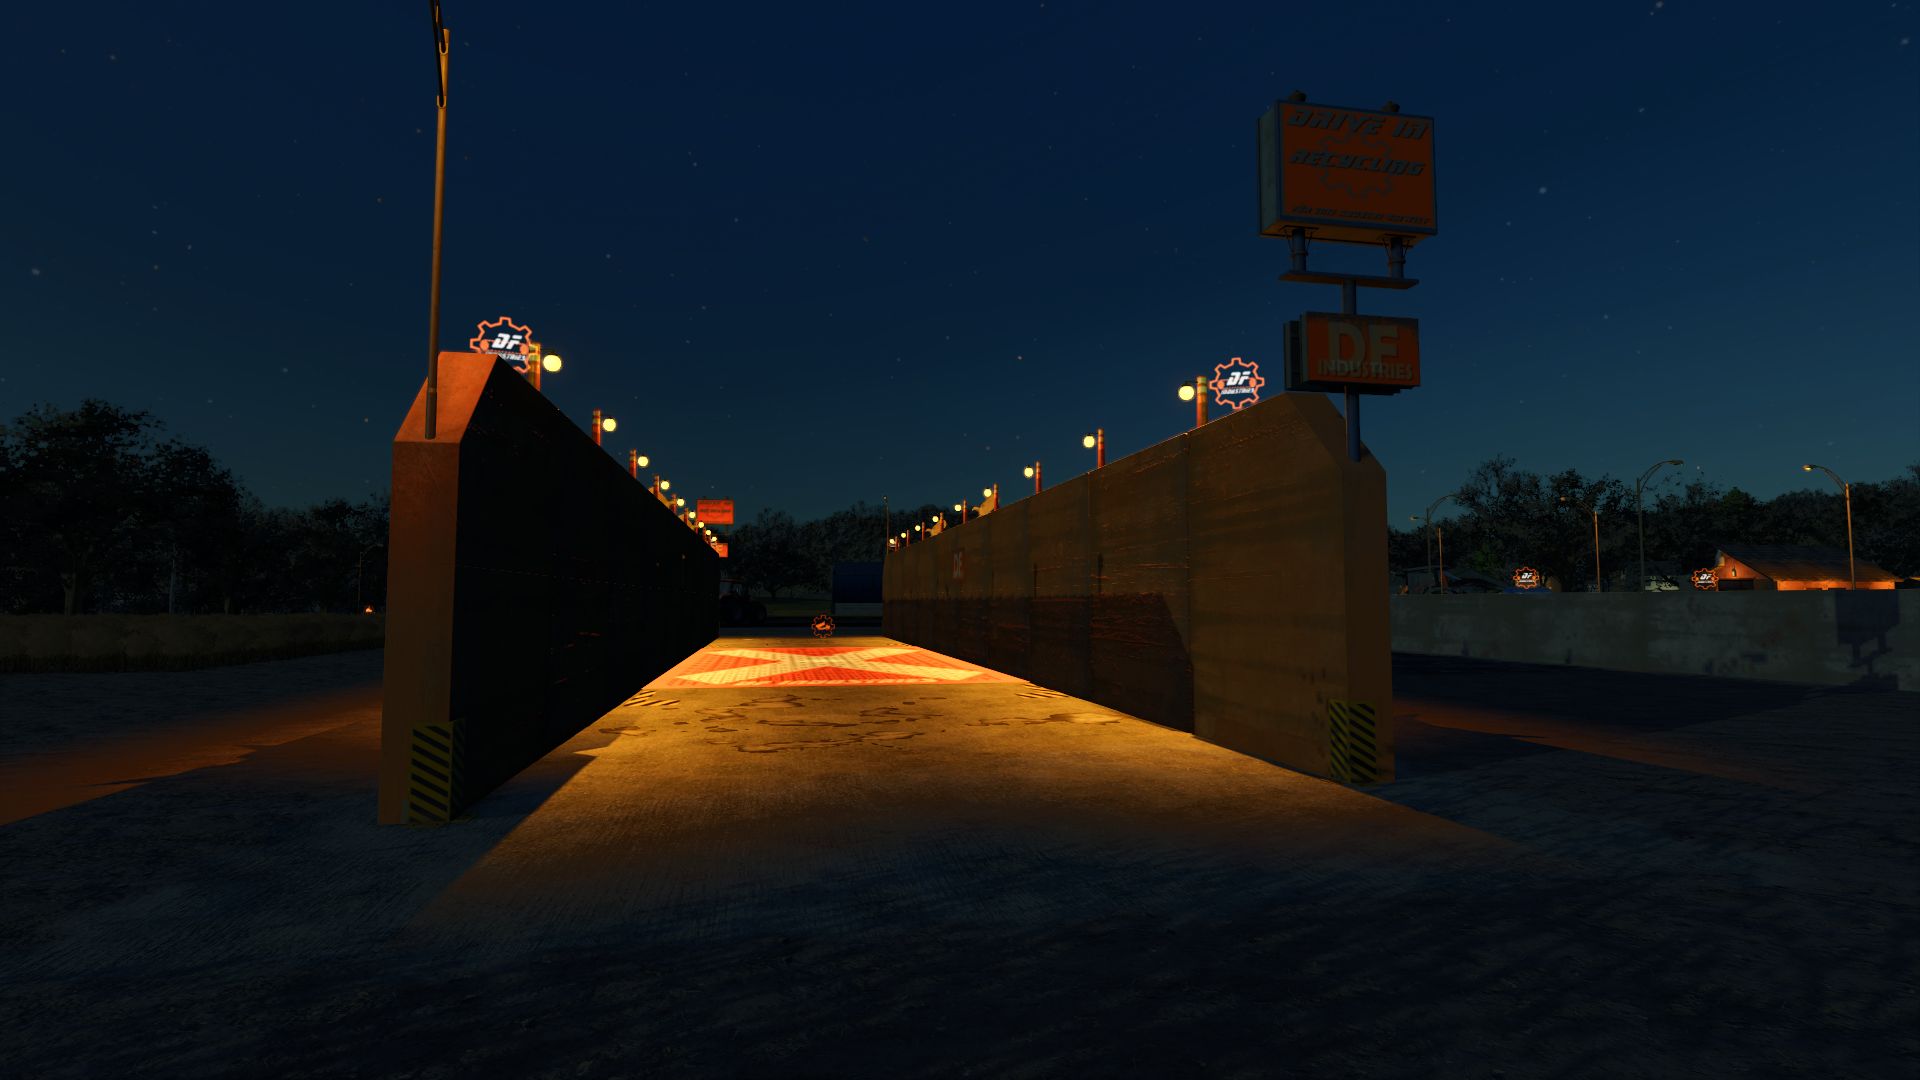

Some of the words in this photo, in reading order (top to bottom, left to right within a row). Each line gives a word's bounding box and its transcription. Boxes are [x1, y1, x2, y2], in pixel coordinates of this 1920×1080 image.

[1288, 109, 1386, 136] DRIVE
[1392, 121, 1428, 140] IN
[1289, 149, 1426, 177] RECYCLING
[492, 332, 523, 350] DF
[1226, 371, 1251, 386] DF
[1317, 359, 1414, 380] INDUSTRIES
